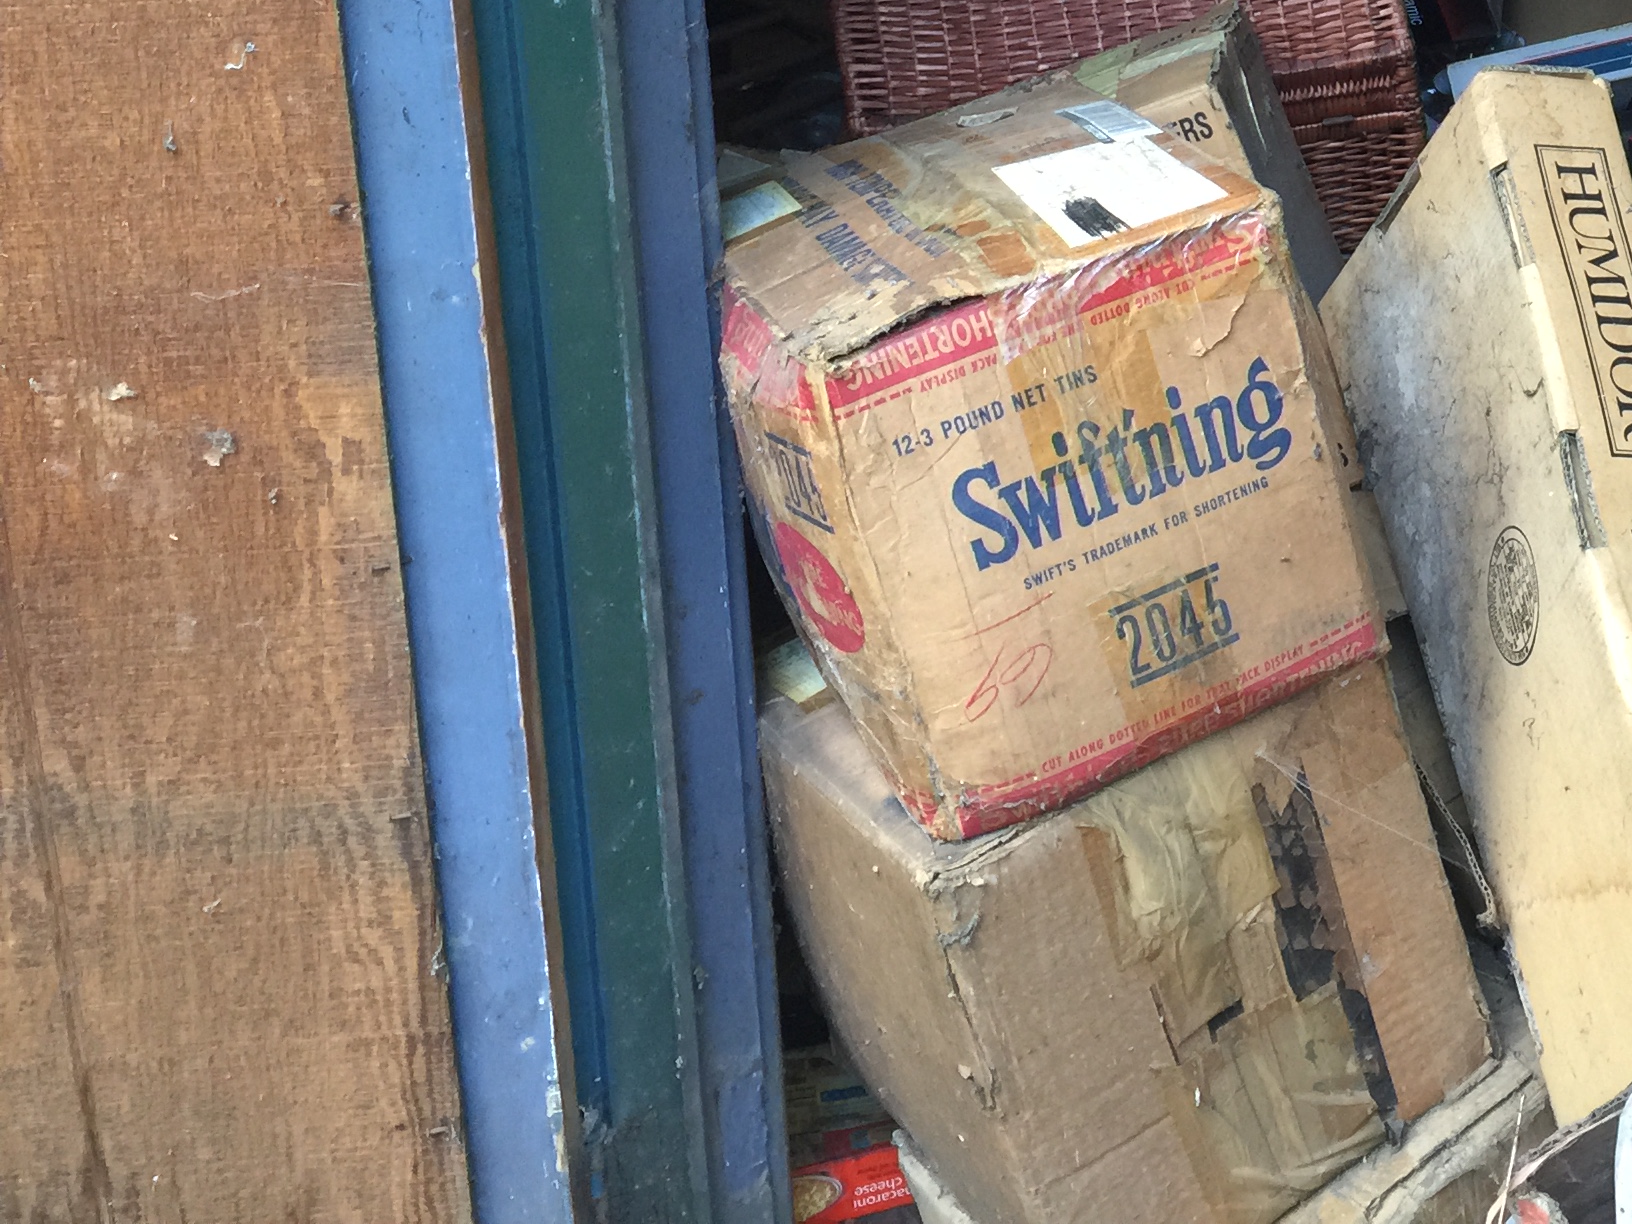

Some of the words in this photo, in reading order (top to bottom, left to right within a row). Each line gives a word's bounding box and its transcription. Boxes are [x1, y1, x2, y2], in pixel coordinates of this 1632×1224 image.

[917, 363, 967, 393] DISPLAY
[972, 353, 998, 373] PACK
[892, 428, 935, 458] 12-3
[940, 399, 1005, 440] POUND
[1012, 383, 1047, 414] NET
[1054, 364, 1099, 396] TINS
[1023, 558, 1078, 591] SWIFT'S
[1081, 522, 1160, 566] TRADEMARK
[1164, 510, 1190, 531] FOR
[1193, 476, 1270, 518] SHORTENING
[1116, 575, 1234, 678] 2045
[1041, 755, 1064, 774] CUT
[1069, 738, 1104, 764] ALONG
[1152, 705, 1178, 726] LINE
[1263, 643, 1305, 674] DISPLAY
[854, 1176, 903, 1196] cheese
